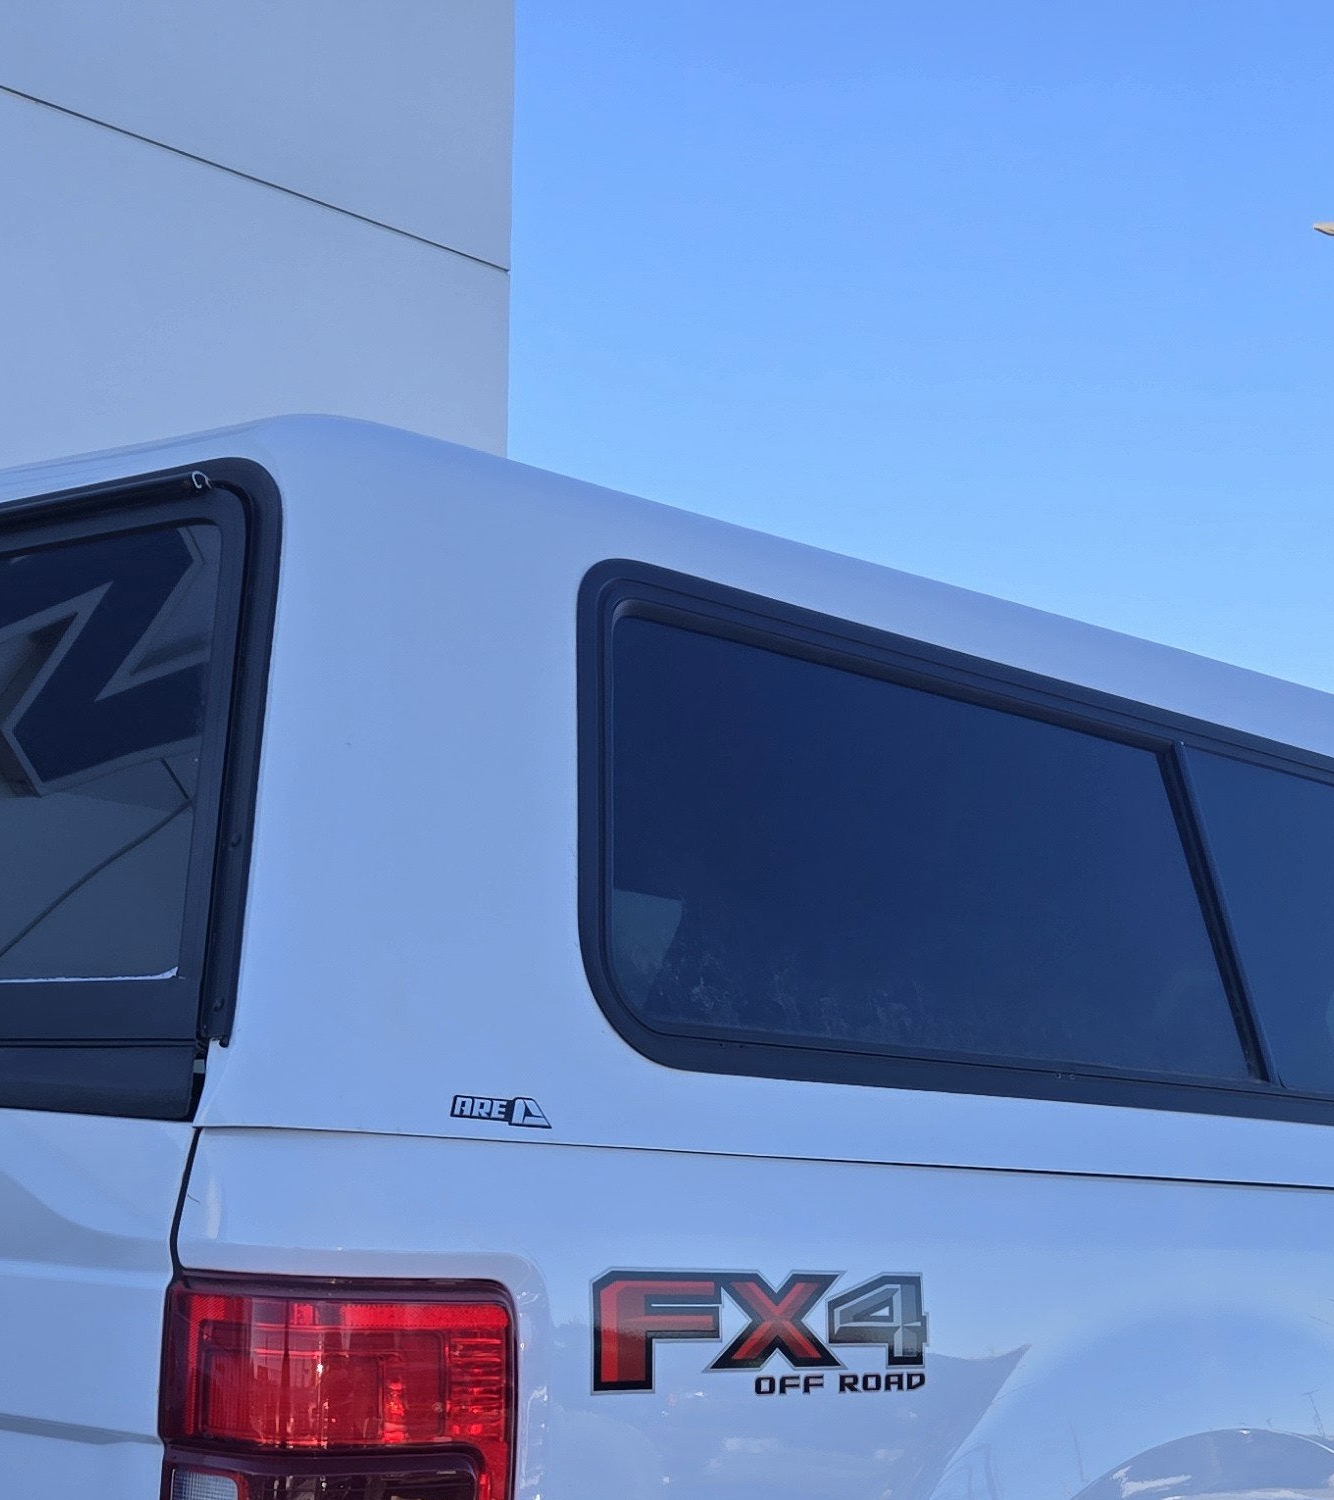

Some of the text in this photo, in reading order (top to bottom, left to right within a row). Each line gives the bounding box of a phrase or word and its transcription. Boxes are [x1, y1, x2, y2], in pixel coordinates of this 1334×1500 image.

[453, 1096, 508, 1119] ARE
[590, 1266, 930, 1396] FX4
[754, 1371, 926, 1396] OFF ROAD
